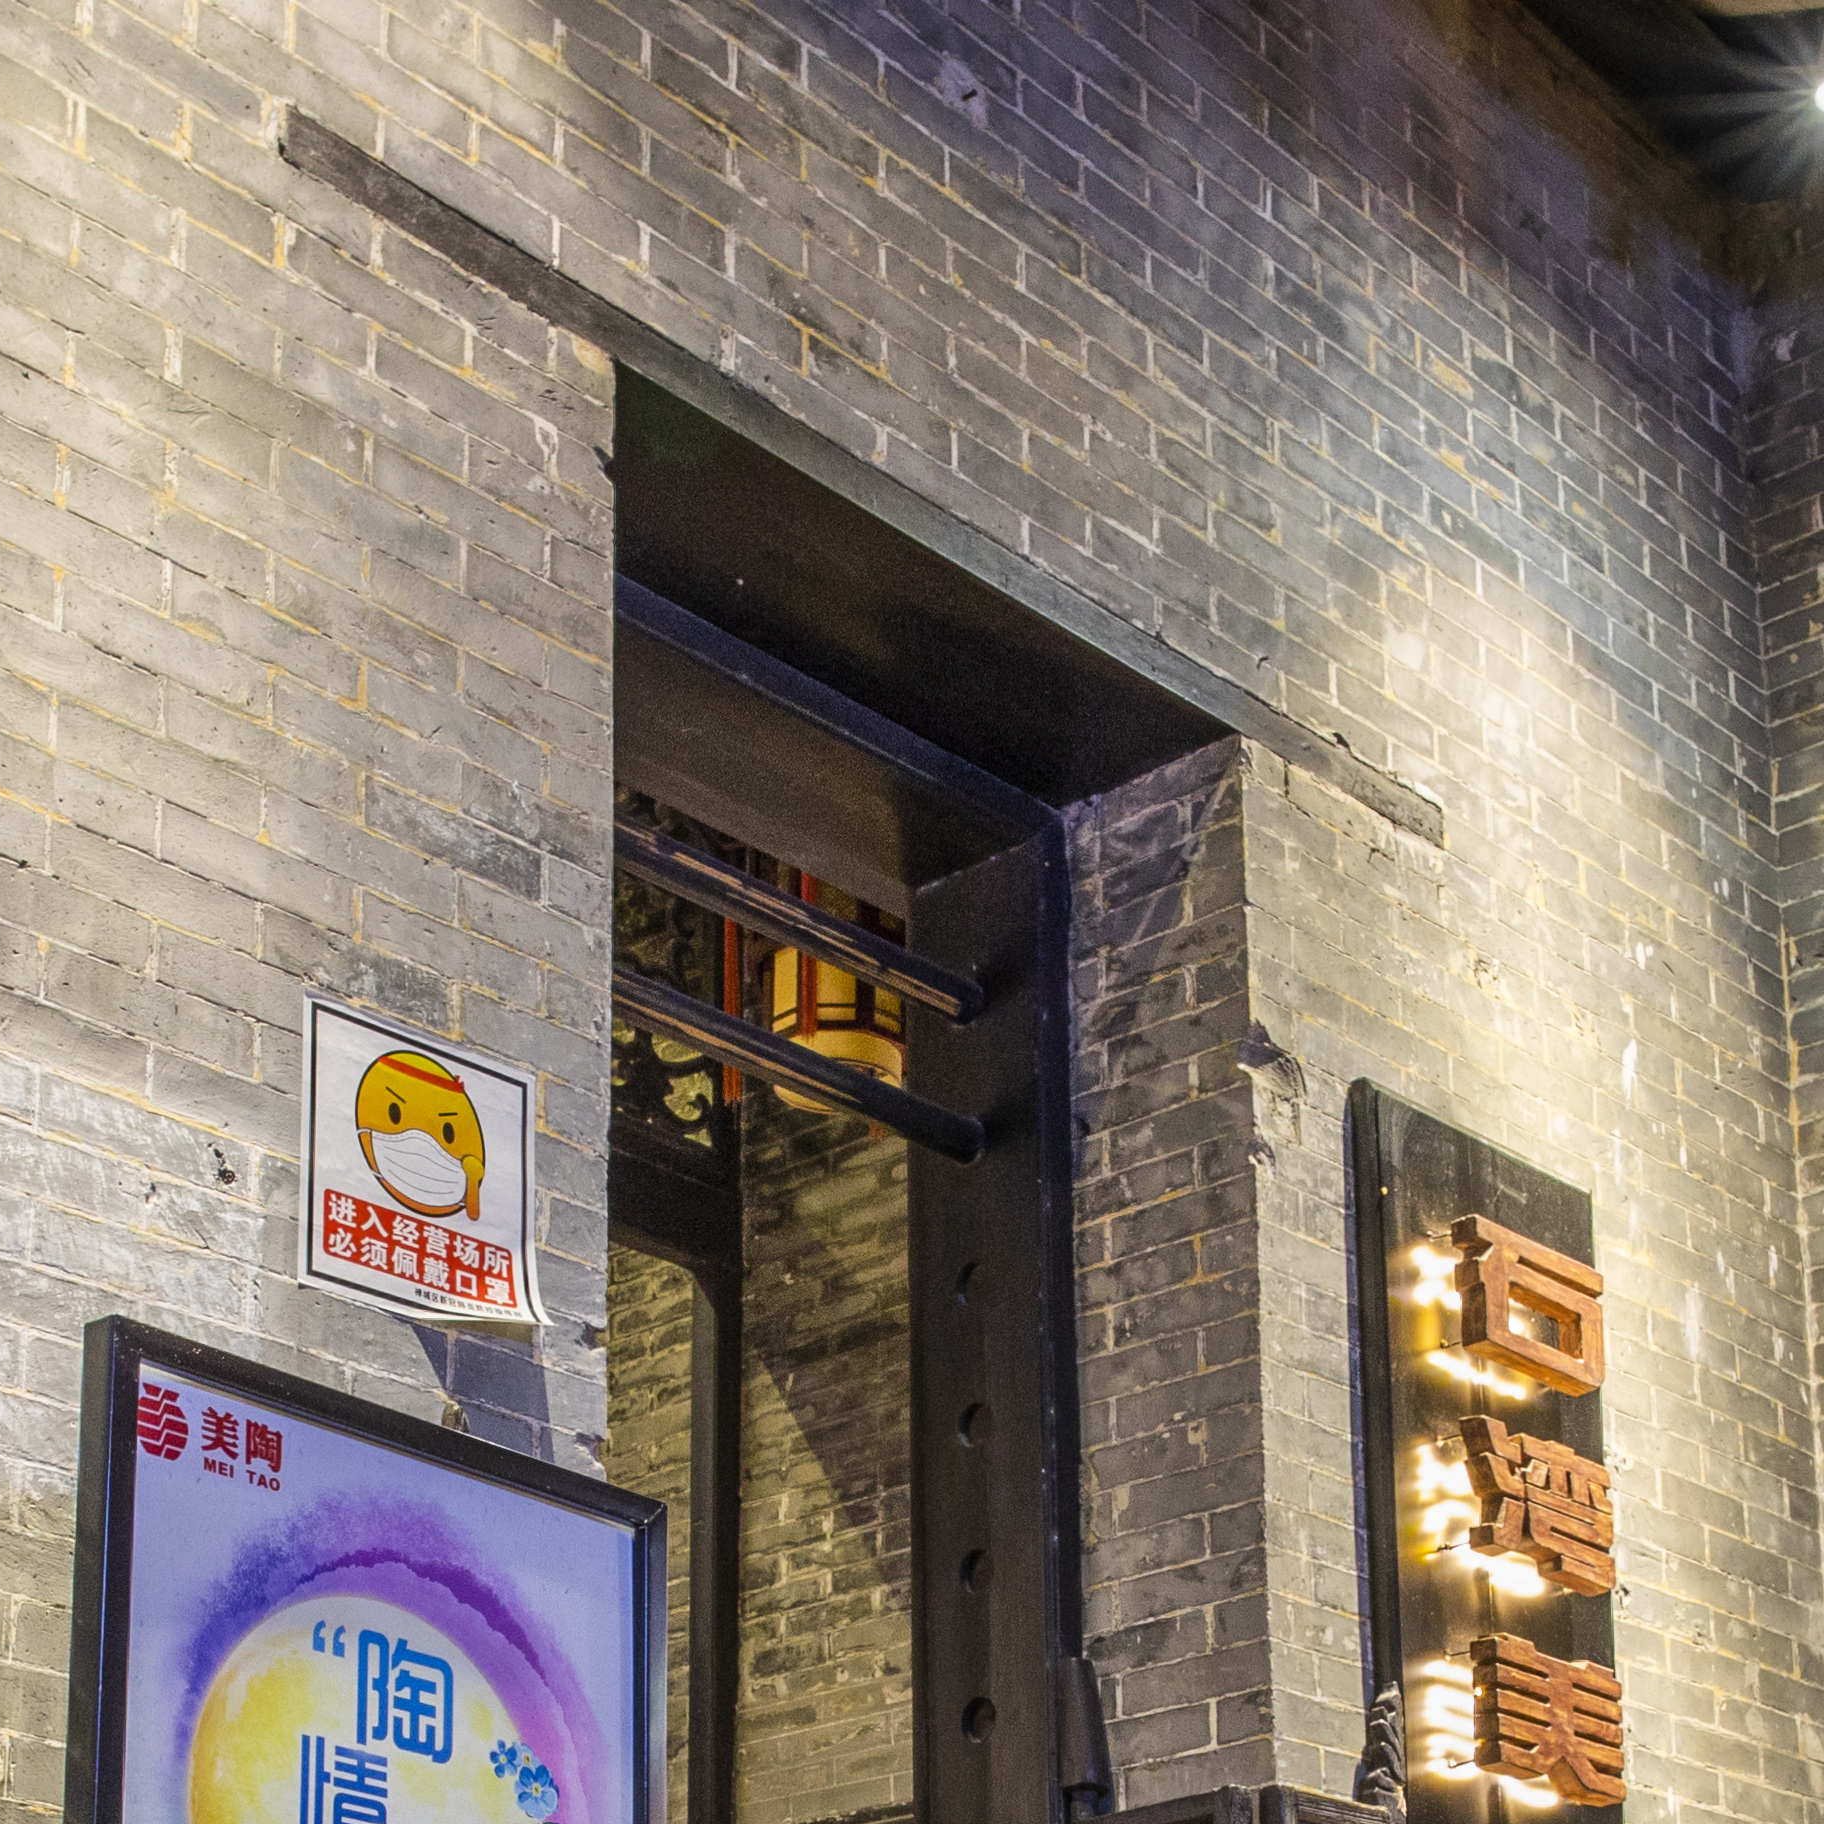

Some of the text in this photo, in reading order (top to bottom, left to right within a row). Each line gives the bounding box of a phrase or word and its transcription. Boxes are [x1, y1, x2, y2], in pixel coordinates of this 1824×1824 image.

[328, 1193, 510, 1278] 进入经营场所
[328, 1228, 514, 1305] 必须佩戴口罩
[201, 1406, 283, 1473] 美陶
[203, 1457, 281, 1491] MEI TAO
